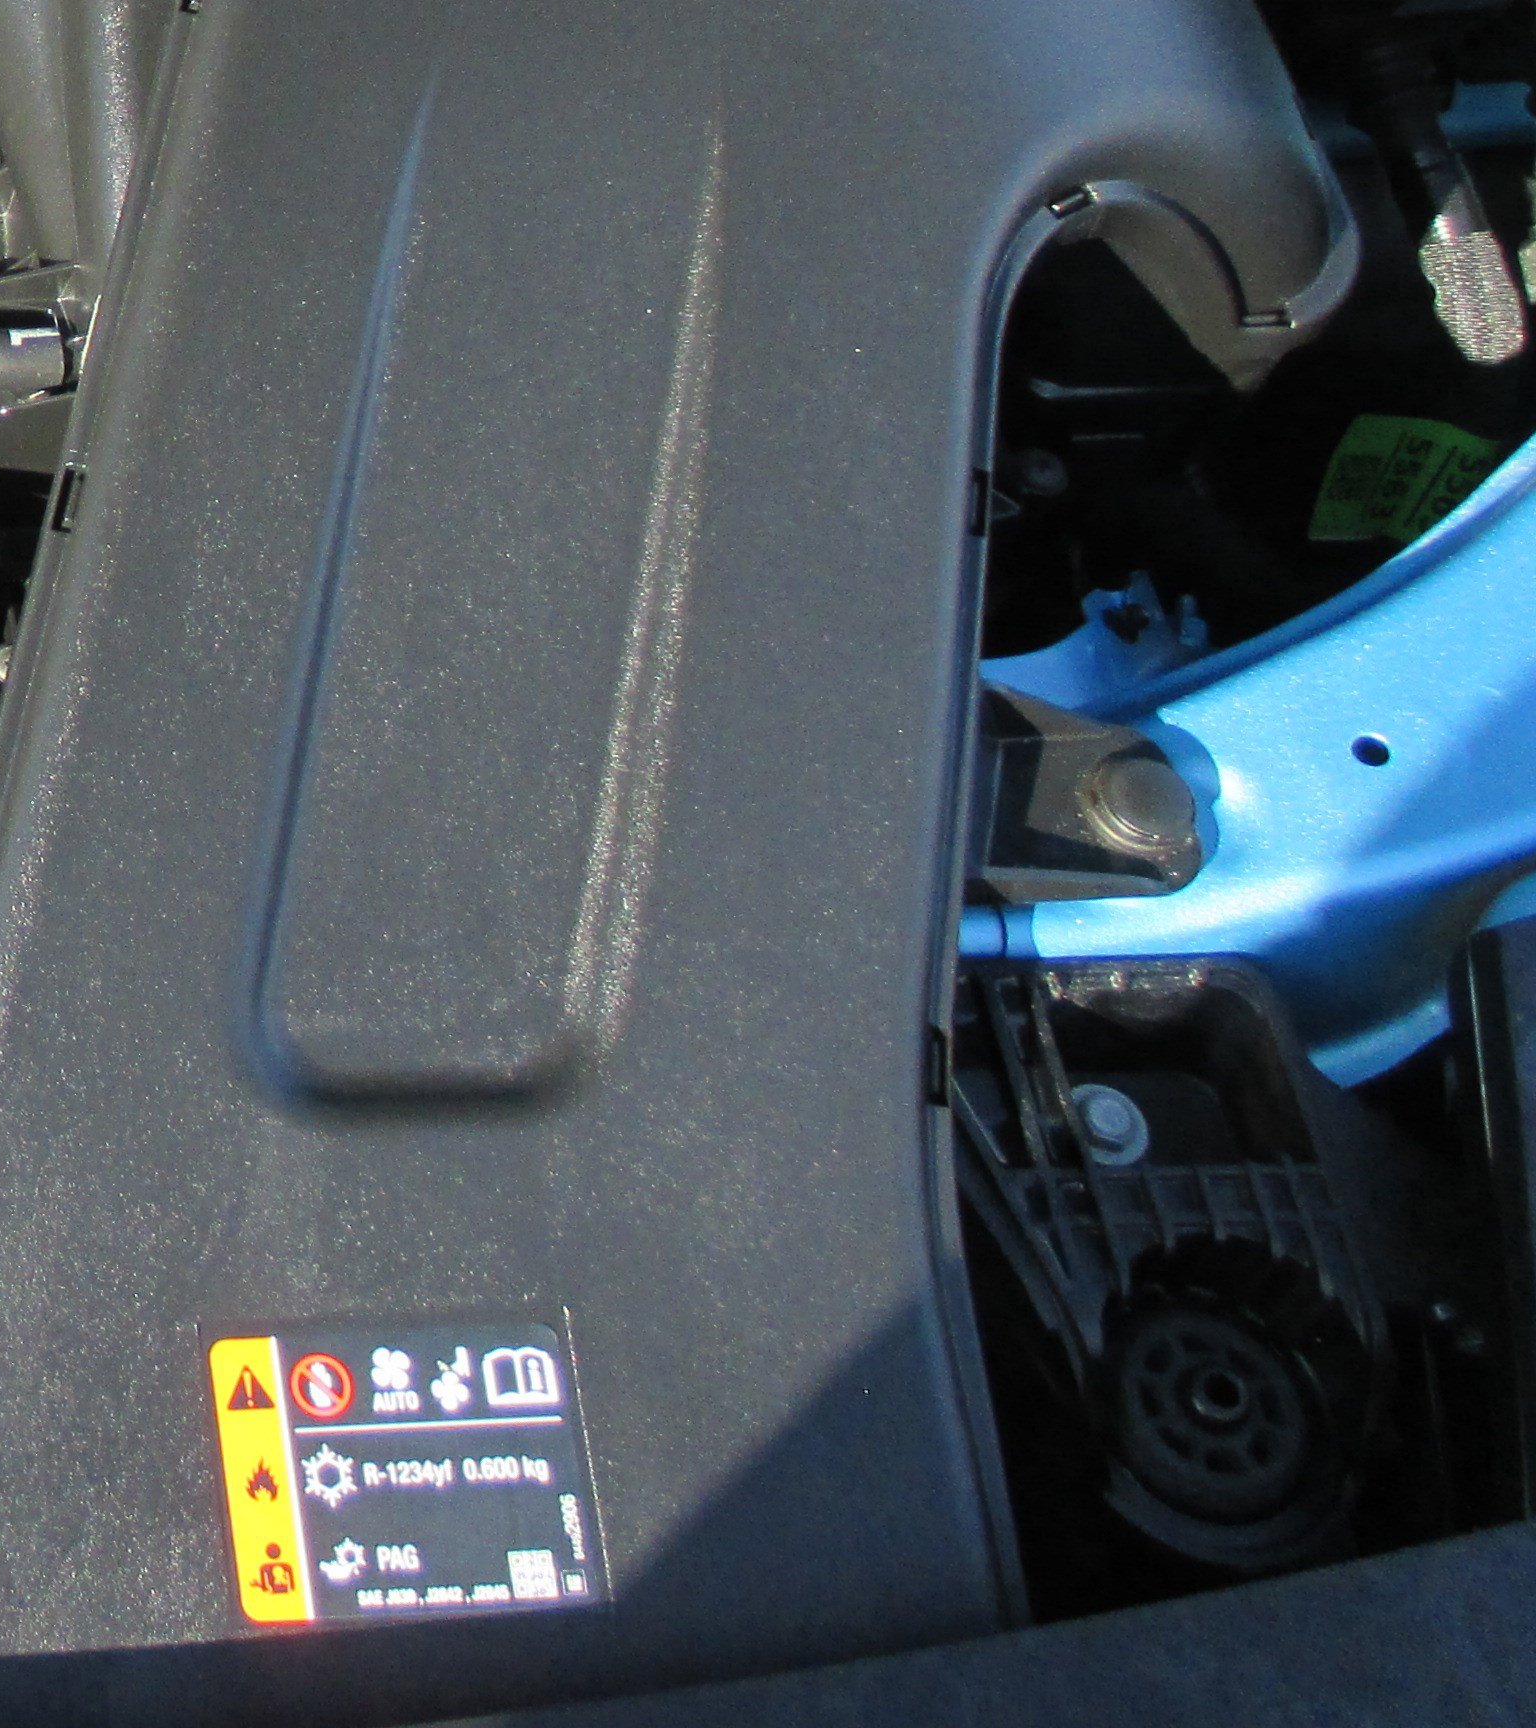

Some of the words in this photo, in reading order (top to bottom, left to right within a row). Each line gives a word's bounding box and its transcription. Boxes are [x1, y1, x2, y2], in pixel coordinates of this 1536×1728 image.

[372, 1390, 420, 1413] AUTO
[364, 1458, 454, 1488] R-1234yf
[463, 1456, 519, 1483] 0.600
[523, 1455, 551, 1484] kg
[374, 1544, 421, 1572] PAG
